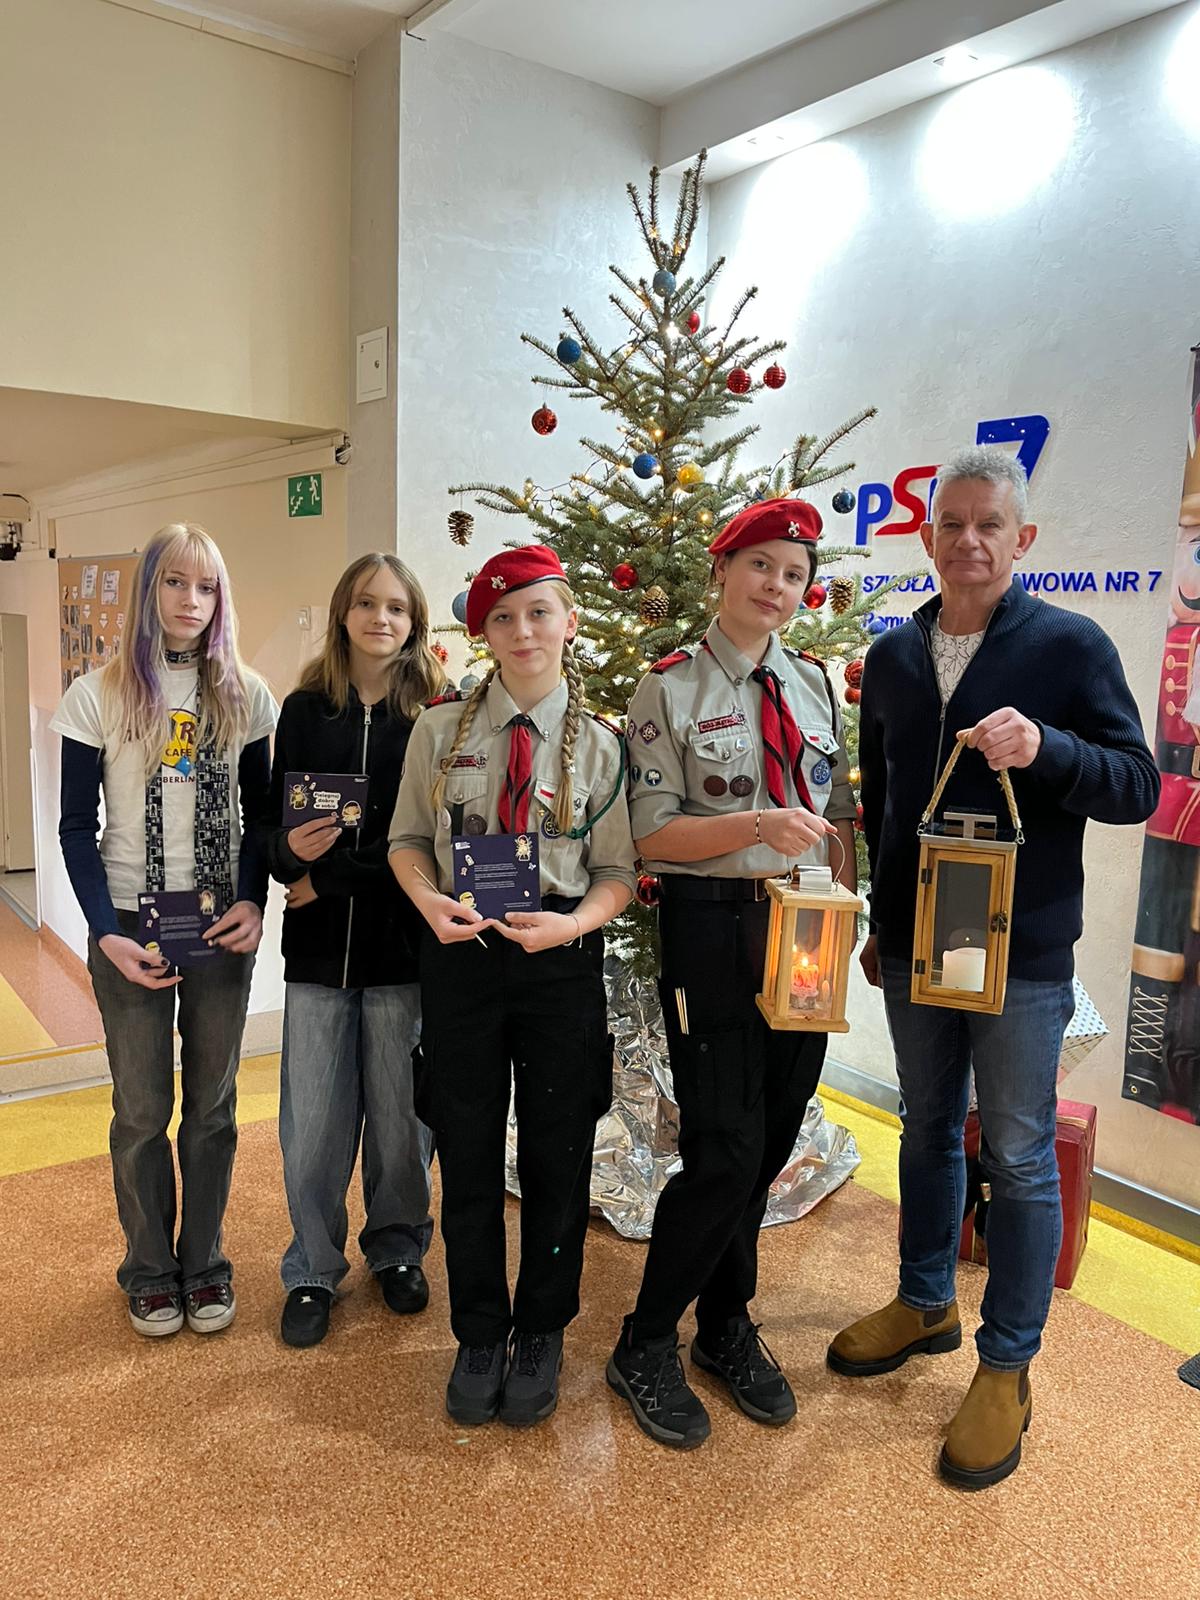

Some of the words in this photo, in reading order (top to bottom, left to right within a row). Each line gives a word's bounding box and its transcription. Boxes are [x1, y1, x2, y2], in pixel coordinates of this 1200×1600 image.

[1105, 571, 1140, 592] NR
[1148, 571, 1163, 592] 7
[165, 748, 192, 757] CAFE
[162, 776, 196, 784] BERLIN
